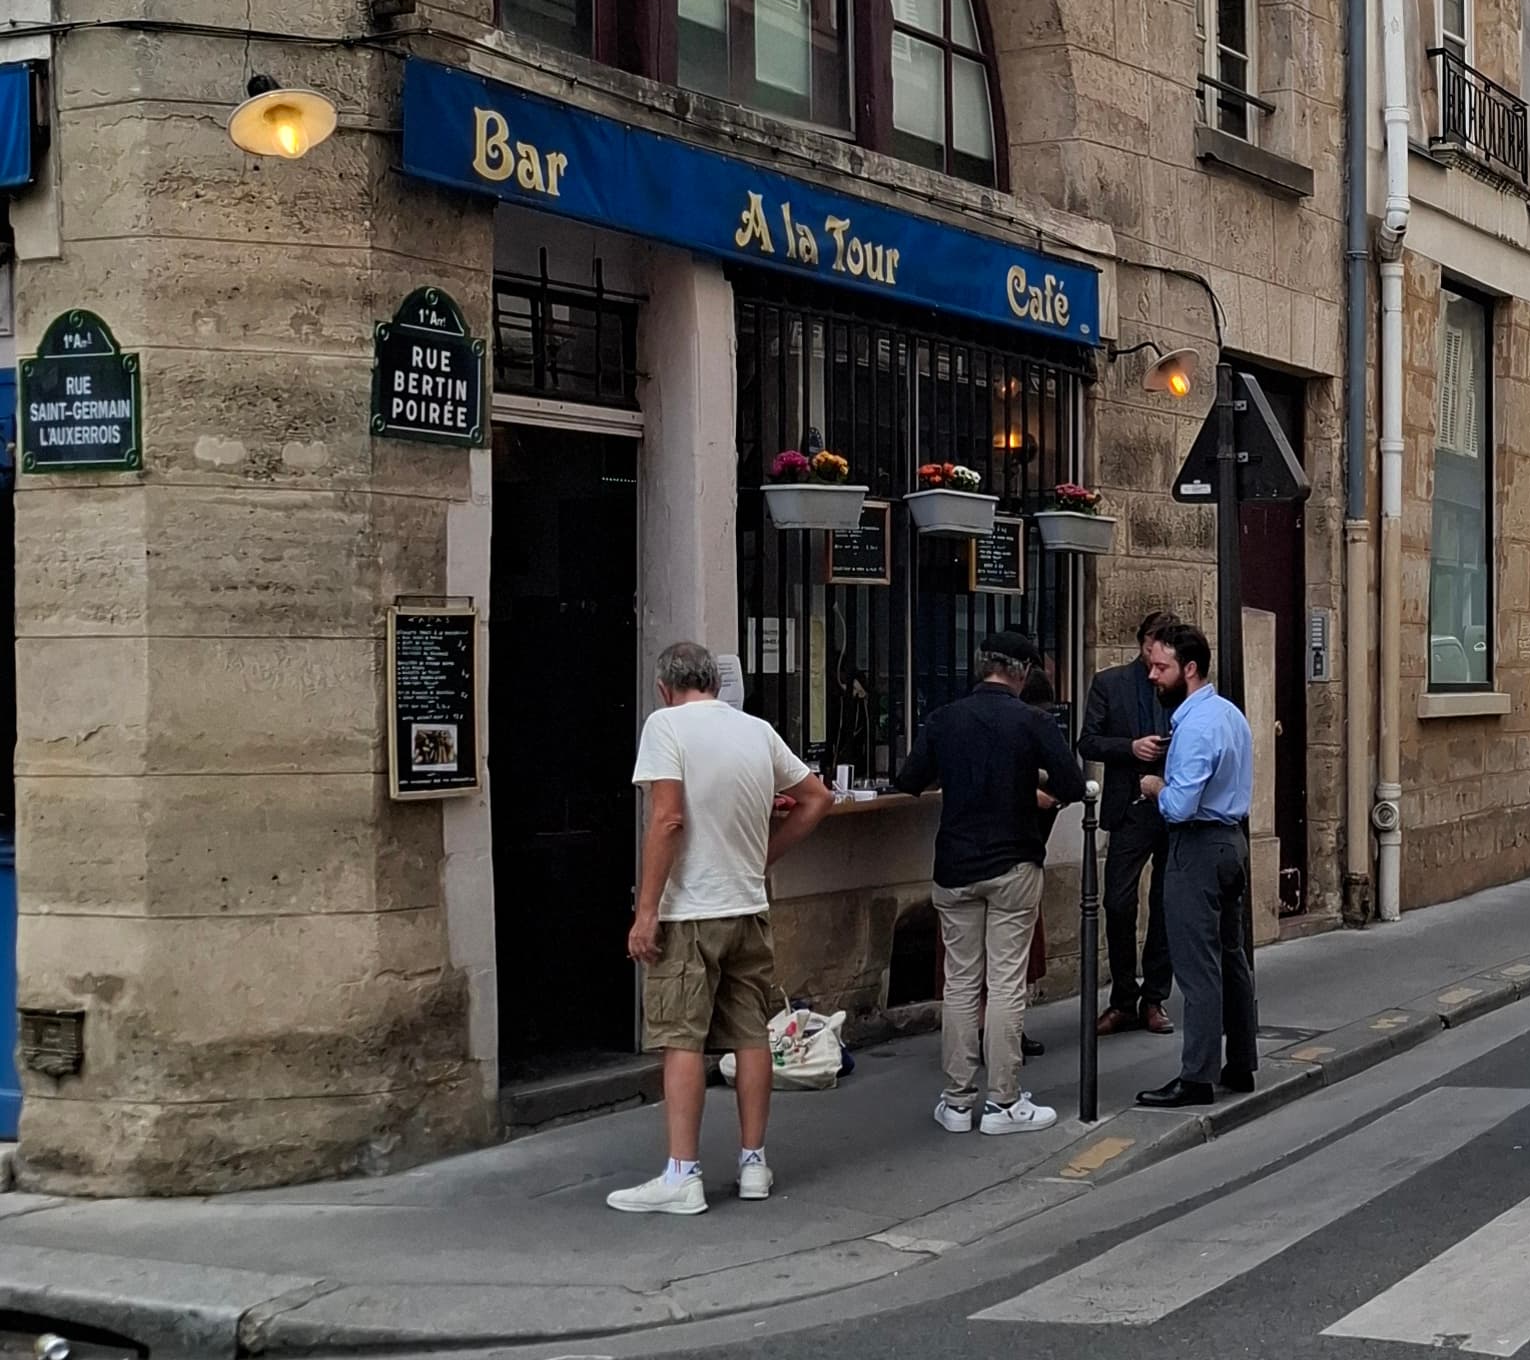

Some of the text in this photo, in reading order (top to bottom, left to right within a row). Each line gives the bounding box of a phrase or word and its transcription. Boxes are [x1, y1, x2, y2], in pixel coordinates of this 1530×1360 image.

[472, 106, 568, 196] Bar
[735, 190, 900, 284] A la Tour
[1007, 264, 1070, 327] Café
[412, 345, 451, 372] RUE
[66, 376, 92, 395] RUE
[393, 370, 467, 401] BERTIN
[29, 400, 130, 421] SAINT-GERMAIN
[392, 397, 467, 428] POIRÉE
[40, 425, 121, 446] L'AUXERROIS
